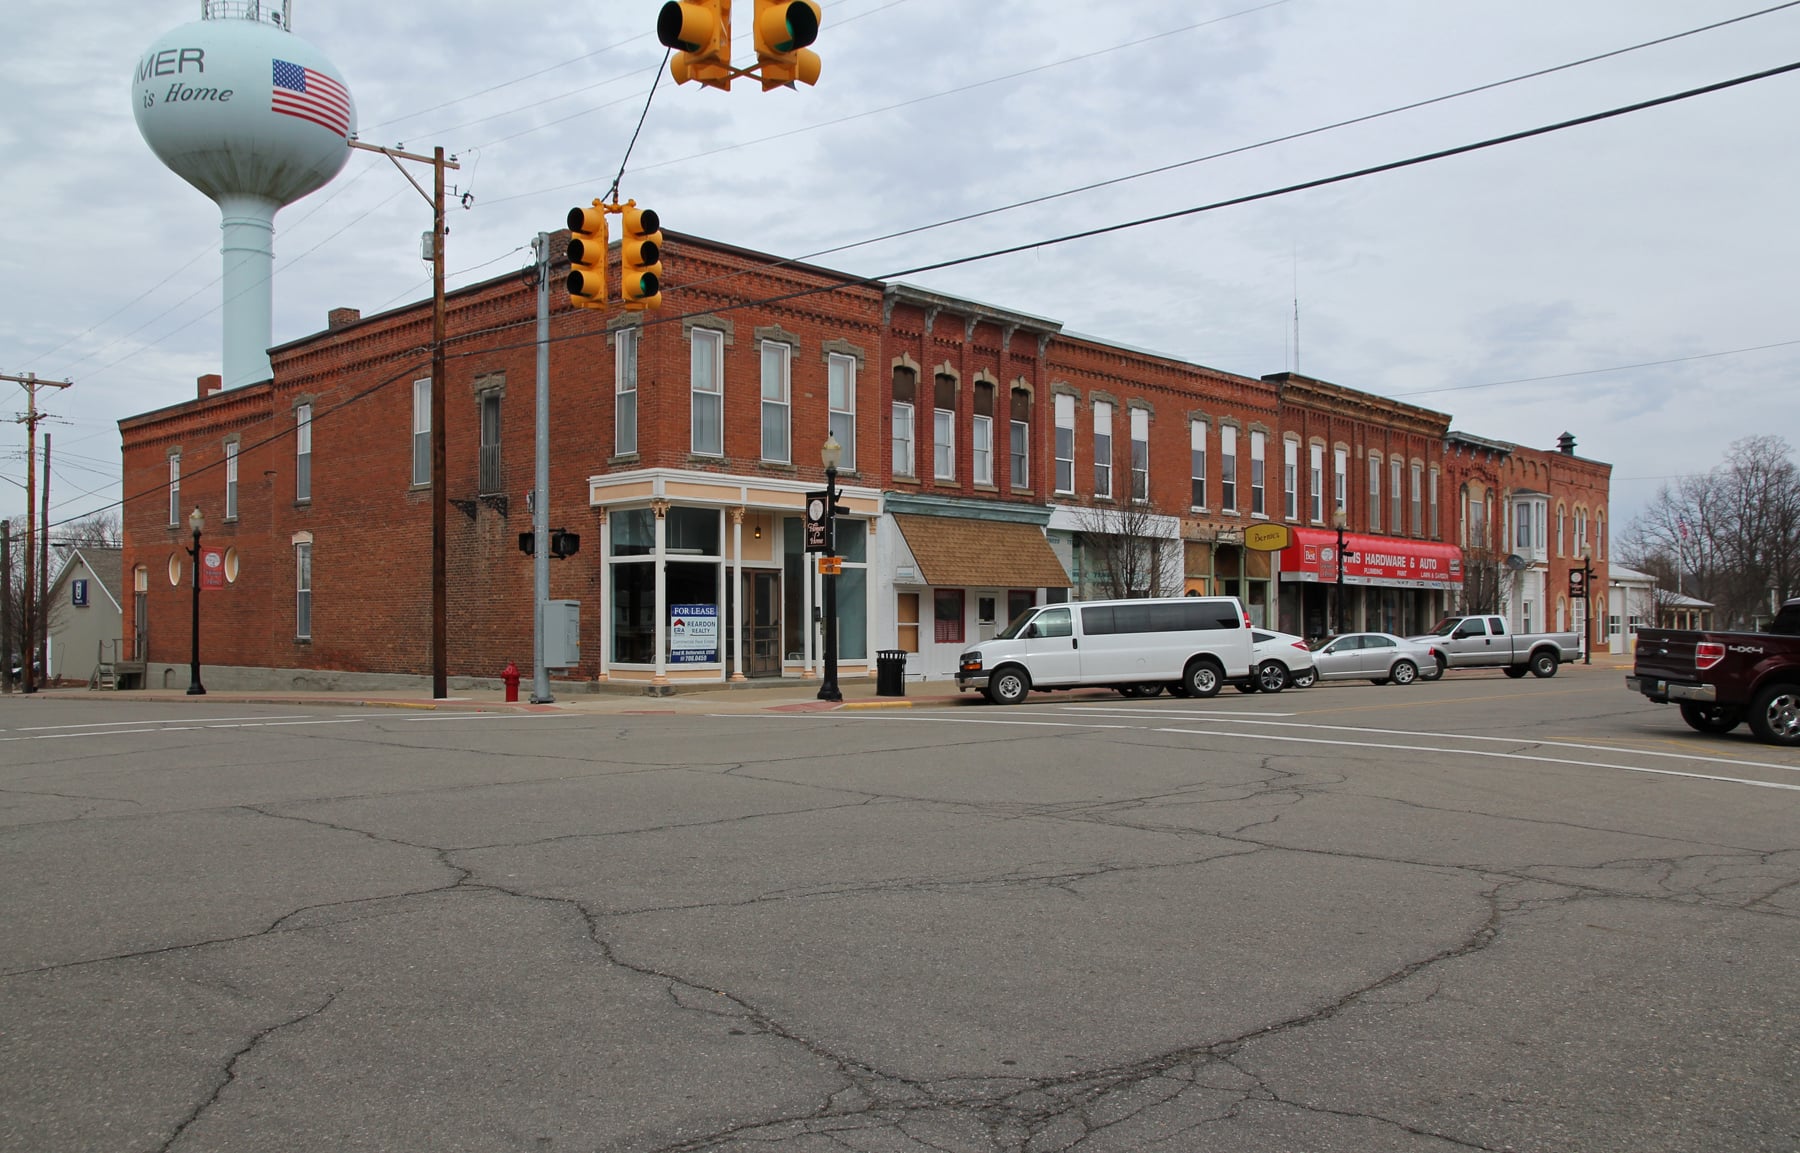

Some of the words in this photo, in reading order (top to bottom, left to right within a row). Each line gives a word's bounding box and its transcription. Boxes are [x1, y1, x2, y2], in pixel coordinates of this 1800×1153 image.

[144, 89, 155, 108] is
[164, 83, 233, 103] Home
[1365, 553, 1406, 568] HARDWARE
[1410, 558, 1415, 568] &
[1419, 559, 1437, 570] AUTO
[674, 607, 690, 615] FOR
[691, 607, 715, 615] LEASE
